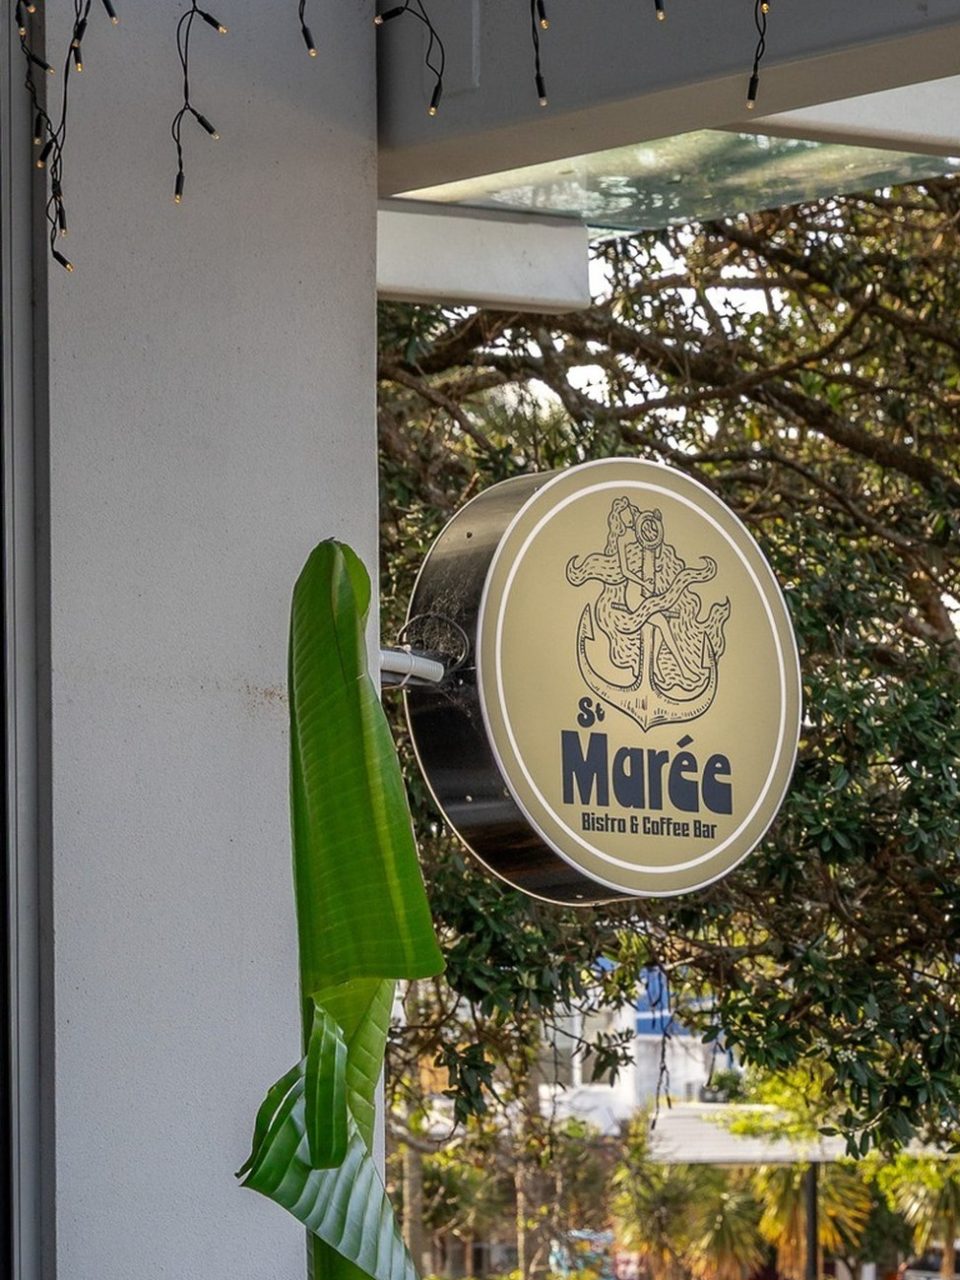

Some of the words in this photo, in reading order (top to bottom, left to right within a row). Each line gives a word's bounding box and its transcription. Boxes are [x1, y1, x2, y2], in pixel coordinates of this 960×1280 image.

[577, 697, 605, 728] St
[561, 730, 733, 815] Marée
[582, 812, 626, 833] Bistro
[630, 816, 639, 834] &
[643, 816, 690, 838] Coffee
[693, 820, 717, 839] Bar
